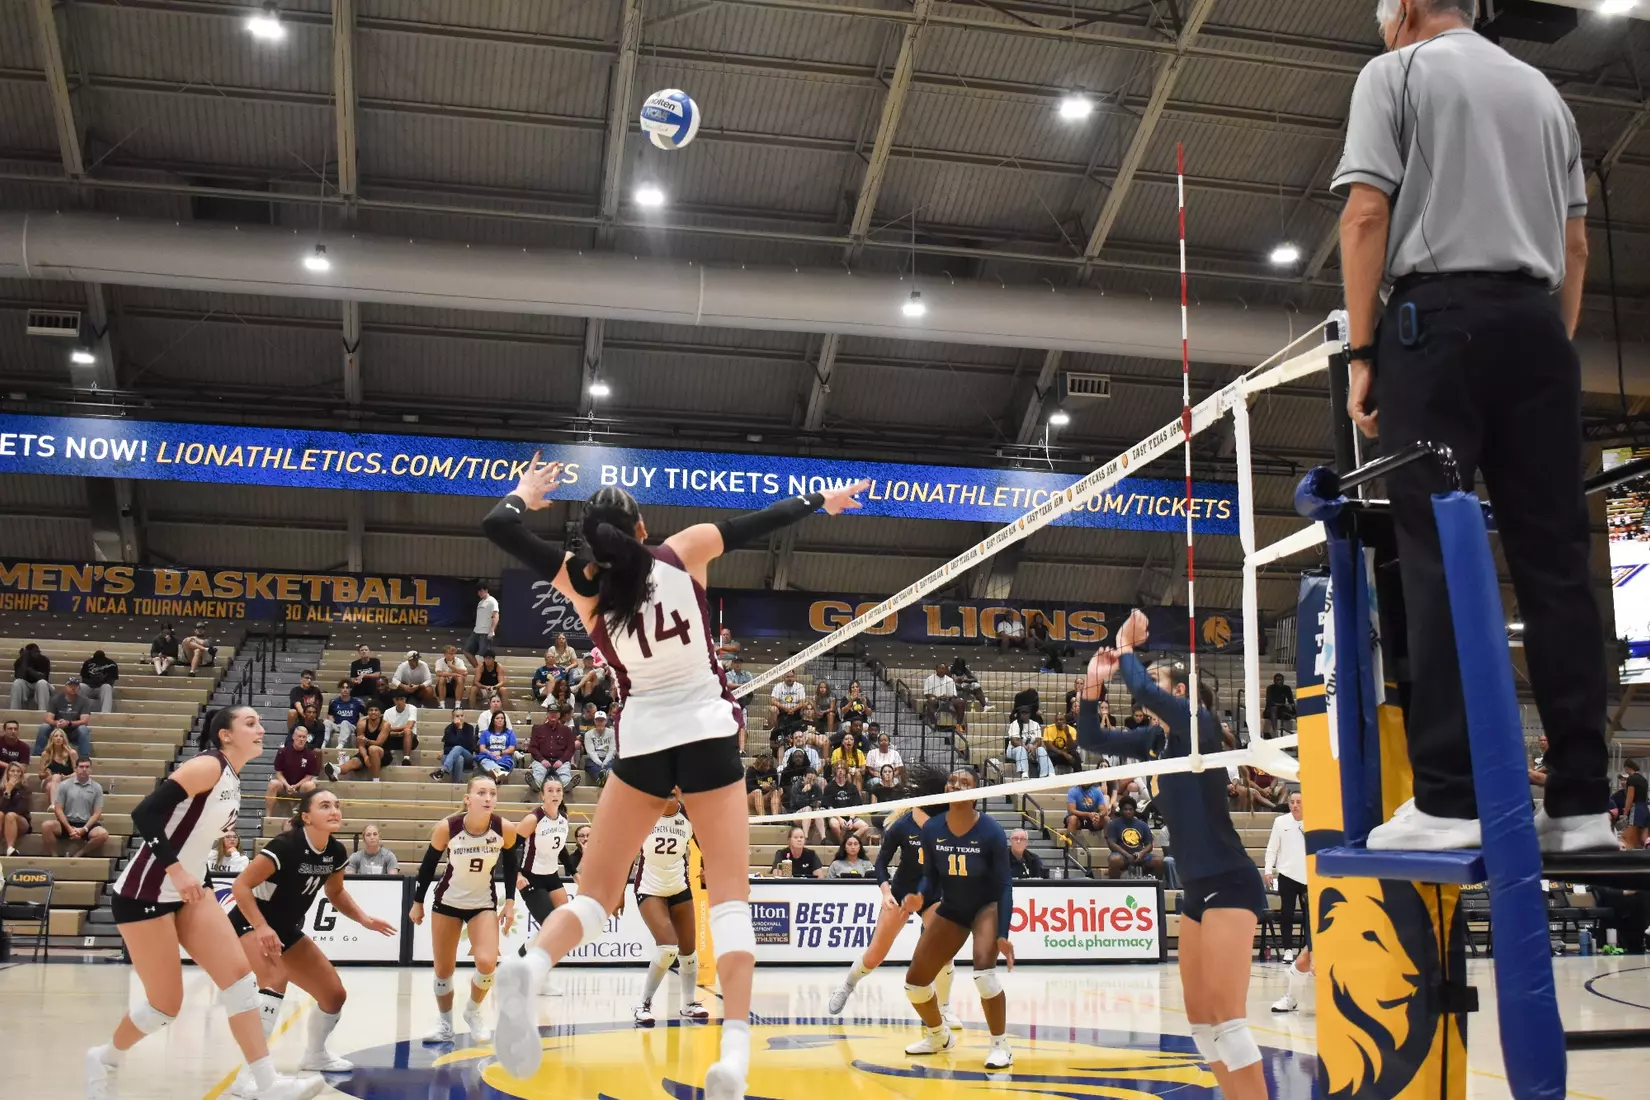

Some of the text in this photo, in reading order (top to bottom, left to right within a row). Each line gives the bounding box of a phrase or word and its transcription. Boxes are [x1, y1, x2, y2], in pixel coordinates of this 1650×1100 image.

[0, 433, 147, 462] ETS NOW!
[601, 464, 860, 499] BUY TICKETS NOW!
[868, 479, 1231, 519] LIONATHLETICOM/TICKETS
[153, 569, 440, 606] BASKETBALL
[72, 596, 82, 612] 7
[85, 597, 127, 615] NCAA
[133, 598, 246, 619] TOURNAMENTS
[306, 605, 429, 626] ALL-AMERICANS
[626, 602, 692, 659] 14
[808, 600, 898, 635] GO
[923, 605, 1109, 642] LIONS
[552, 836, 561, 850] 3
[654, 837, 677, 855] 22
[956, 846, 981, 854] TEXAS
[469, 858, 484, 873] 9
[947, 854, 968, 877] 11
[12, 874, 48, 882] LIONS
[301, 876, 321, 895] 11
[313, 897, 340, 932] G
[795, 902, 849, 924] BEST
[797, 926, 877, 948] TO STAY
